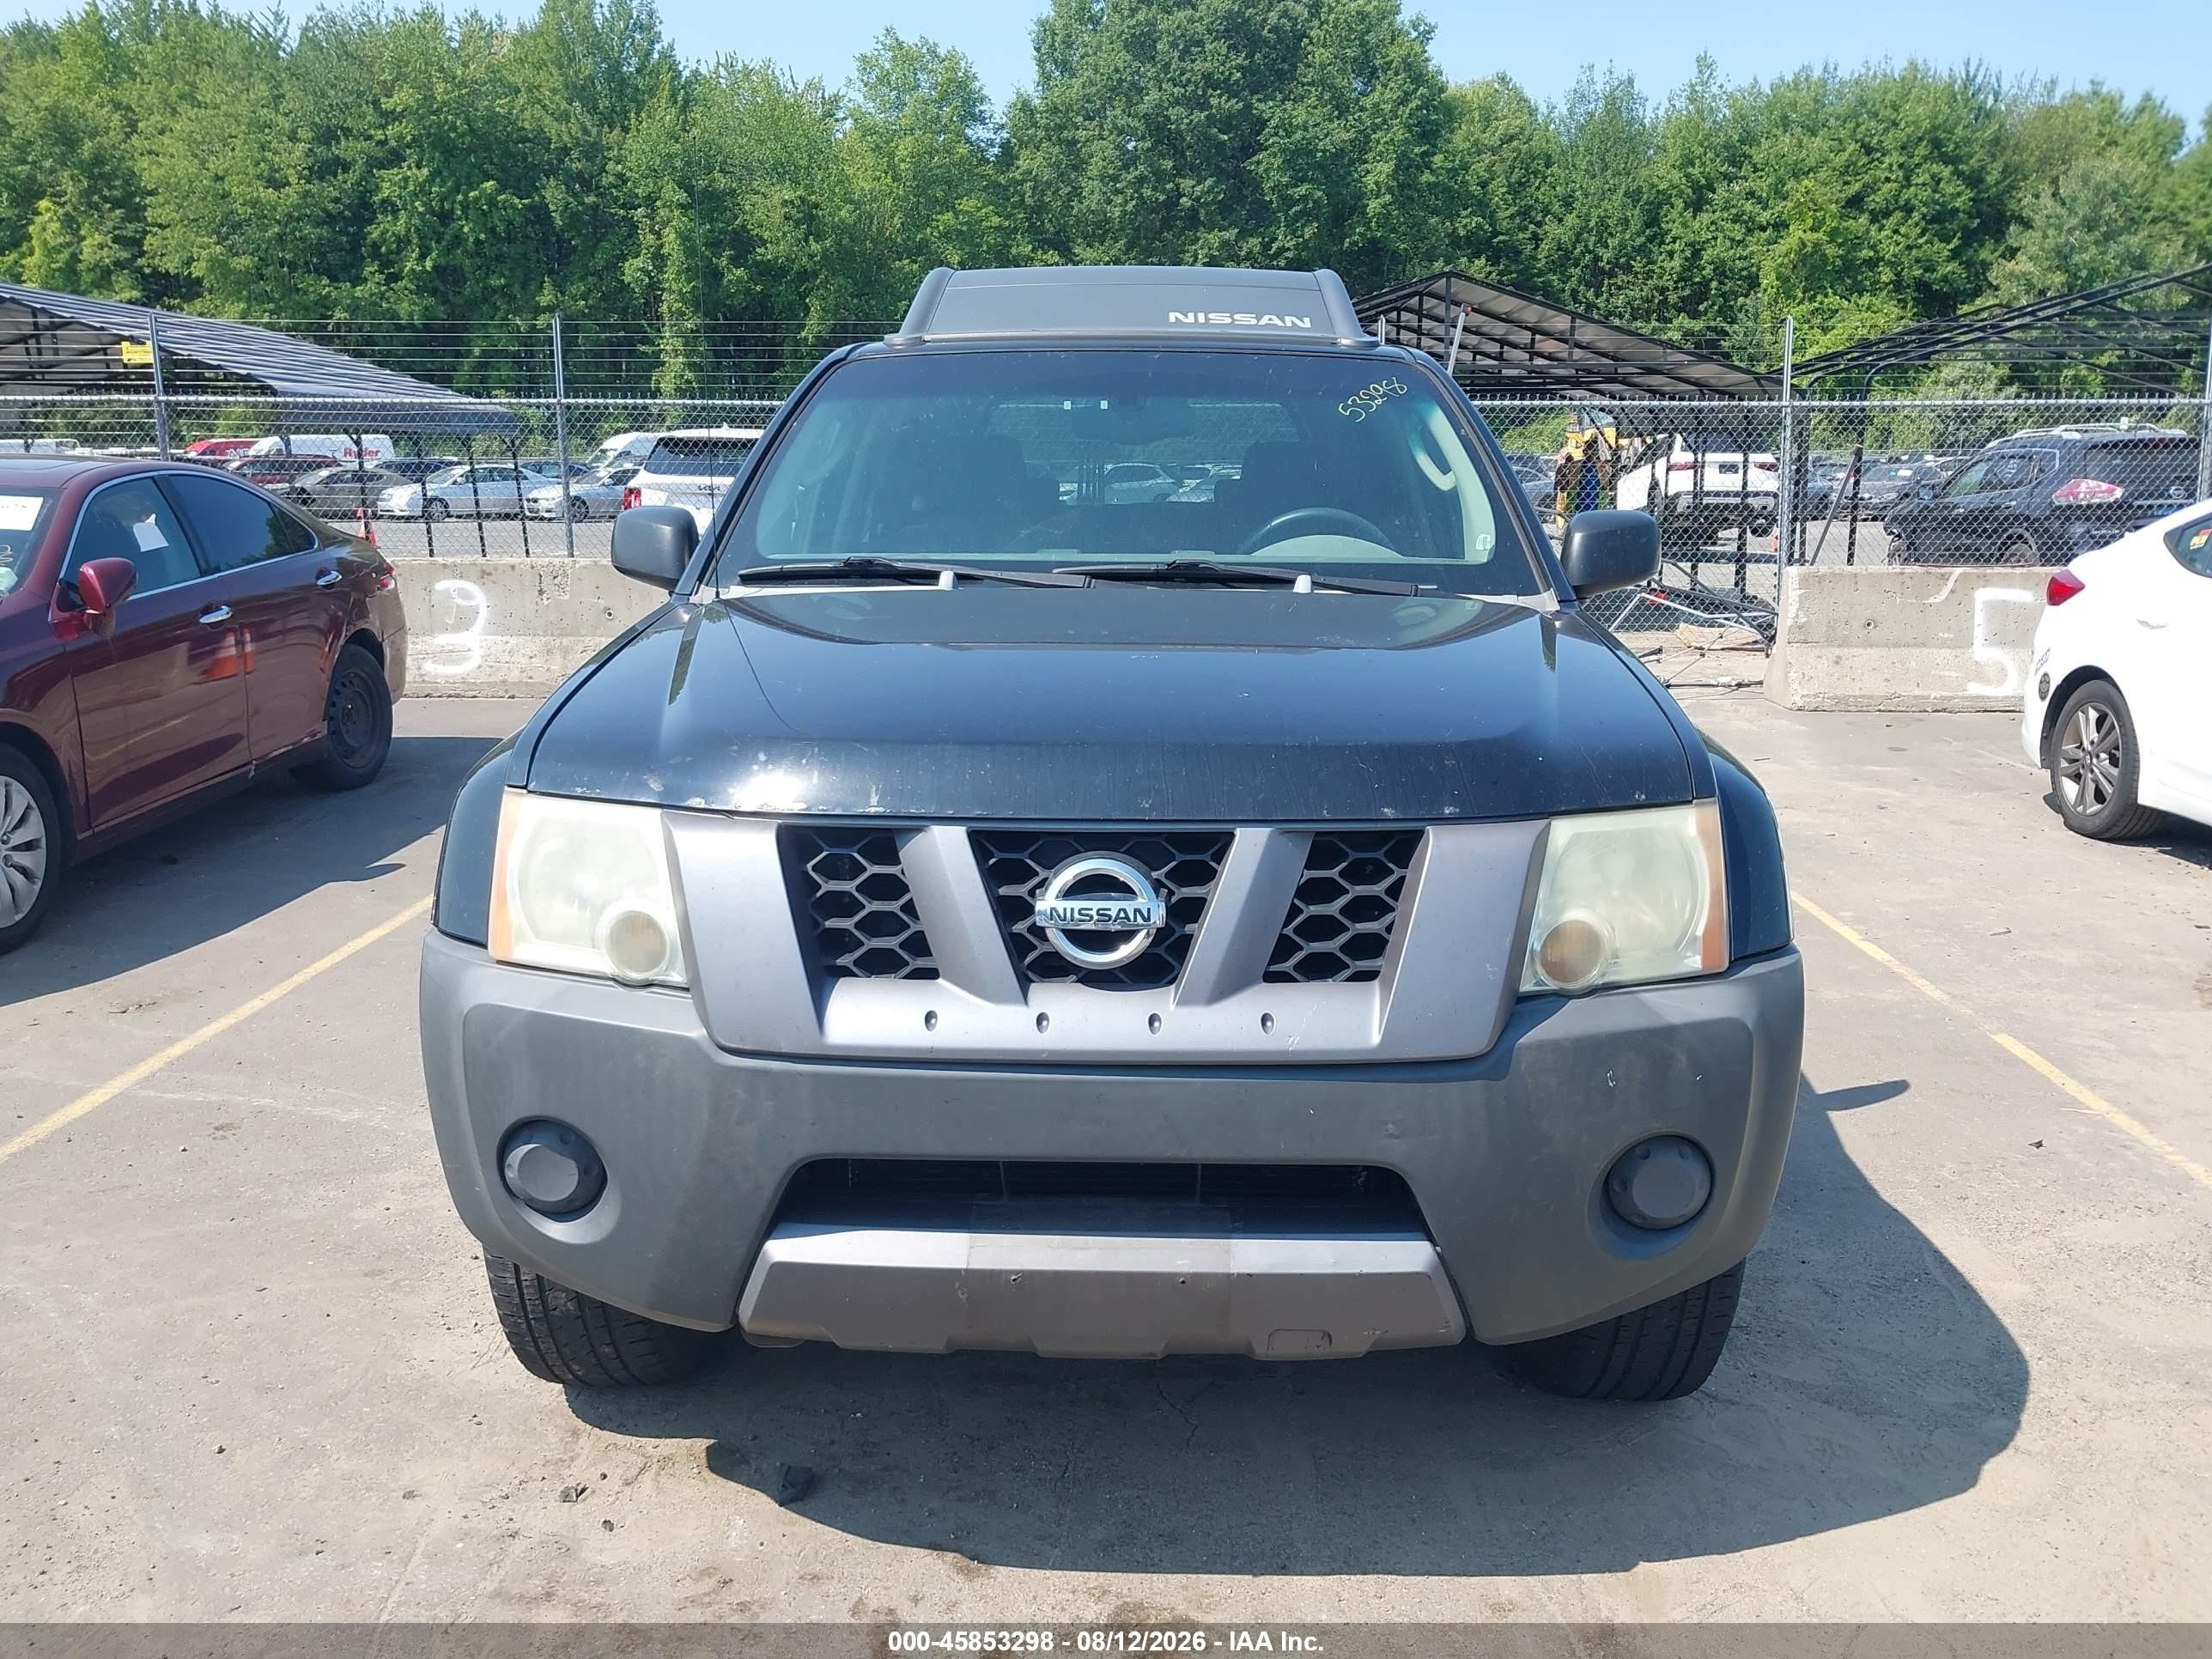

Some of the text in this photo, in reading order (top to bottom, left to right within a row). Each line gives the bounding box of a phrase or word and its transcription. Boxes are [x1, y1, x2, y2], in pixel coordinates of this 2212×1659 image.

[1168, 311, 1312, 329] NISSAN
[1338, 376, 1408, 422] 53298
[423, 580, 487, 674] 3
[1965, 586, 2034, 697] 5
[1048, 906, 1152, 924] NISSAN
